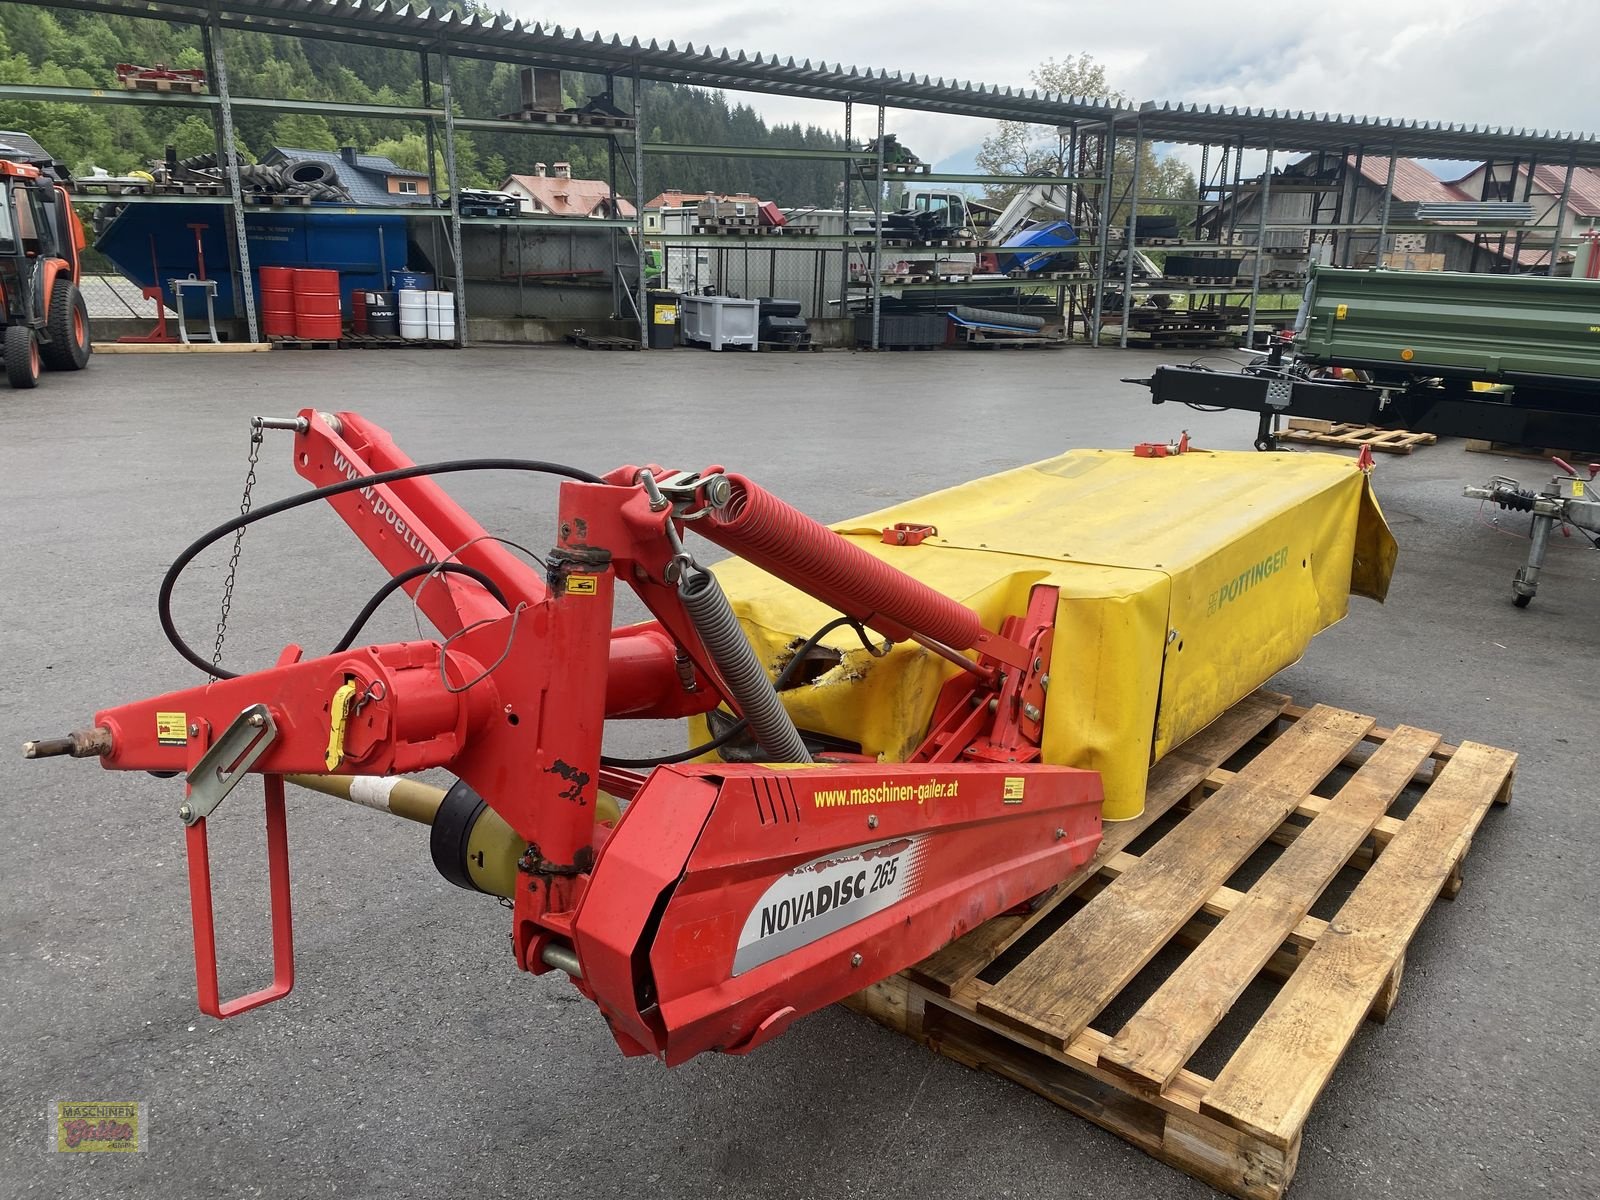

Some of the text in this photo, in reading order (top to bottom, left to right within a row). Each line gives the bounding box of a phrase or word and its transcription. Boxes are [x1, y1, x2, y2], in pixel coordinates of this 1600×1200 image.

[814, 778, 959, 808] www.maschinen-gailer.at
[760, 856, 900, 938] NOVADISC 265
